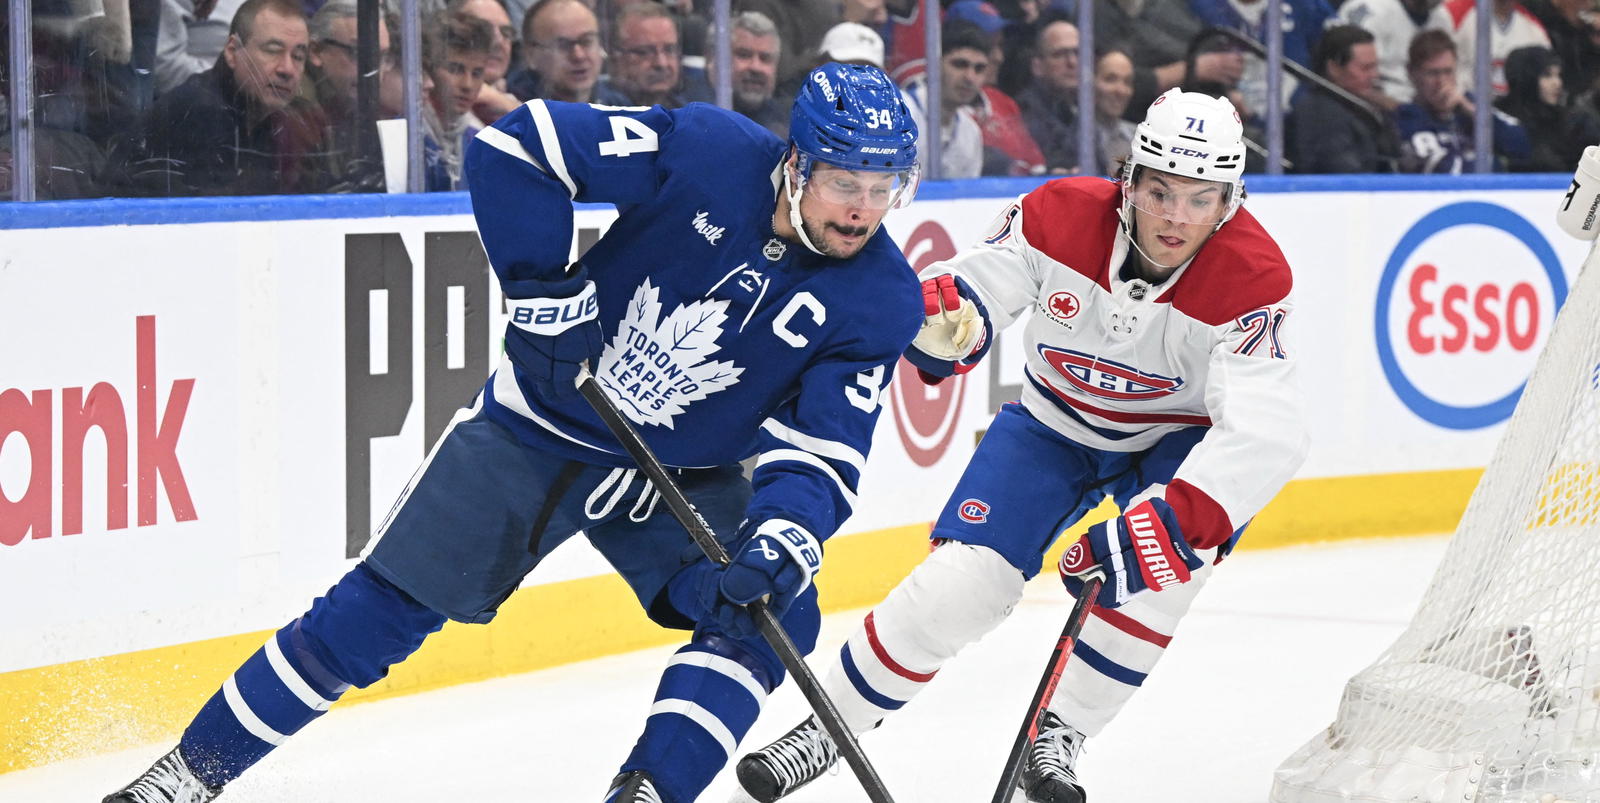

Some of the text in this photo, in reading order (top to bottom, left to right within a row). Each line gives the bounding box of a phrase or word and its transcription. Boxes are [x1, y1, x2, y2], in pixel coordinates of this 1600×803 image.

[813, 71, 835, 103] OREO
[864, 107, 893, 130] 34
[1185, 116, 1205, 133] 71
[860, 146, 898, 155] BAUER
[1170, 146, 1210, 159] CCM
[772, 291, 826, 348] C
[1046, 313, 1073, 331] CANADA
[1407, 263, 1540, 355] Esso
[1233, 307, 1287, 360] 71
[621, 347, 678, 400] MAPLE
[626, 325, 699, 396] TORONTO
[609, 360, 666, 411] LEAFS
